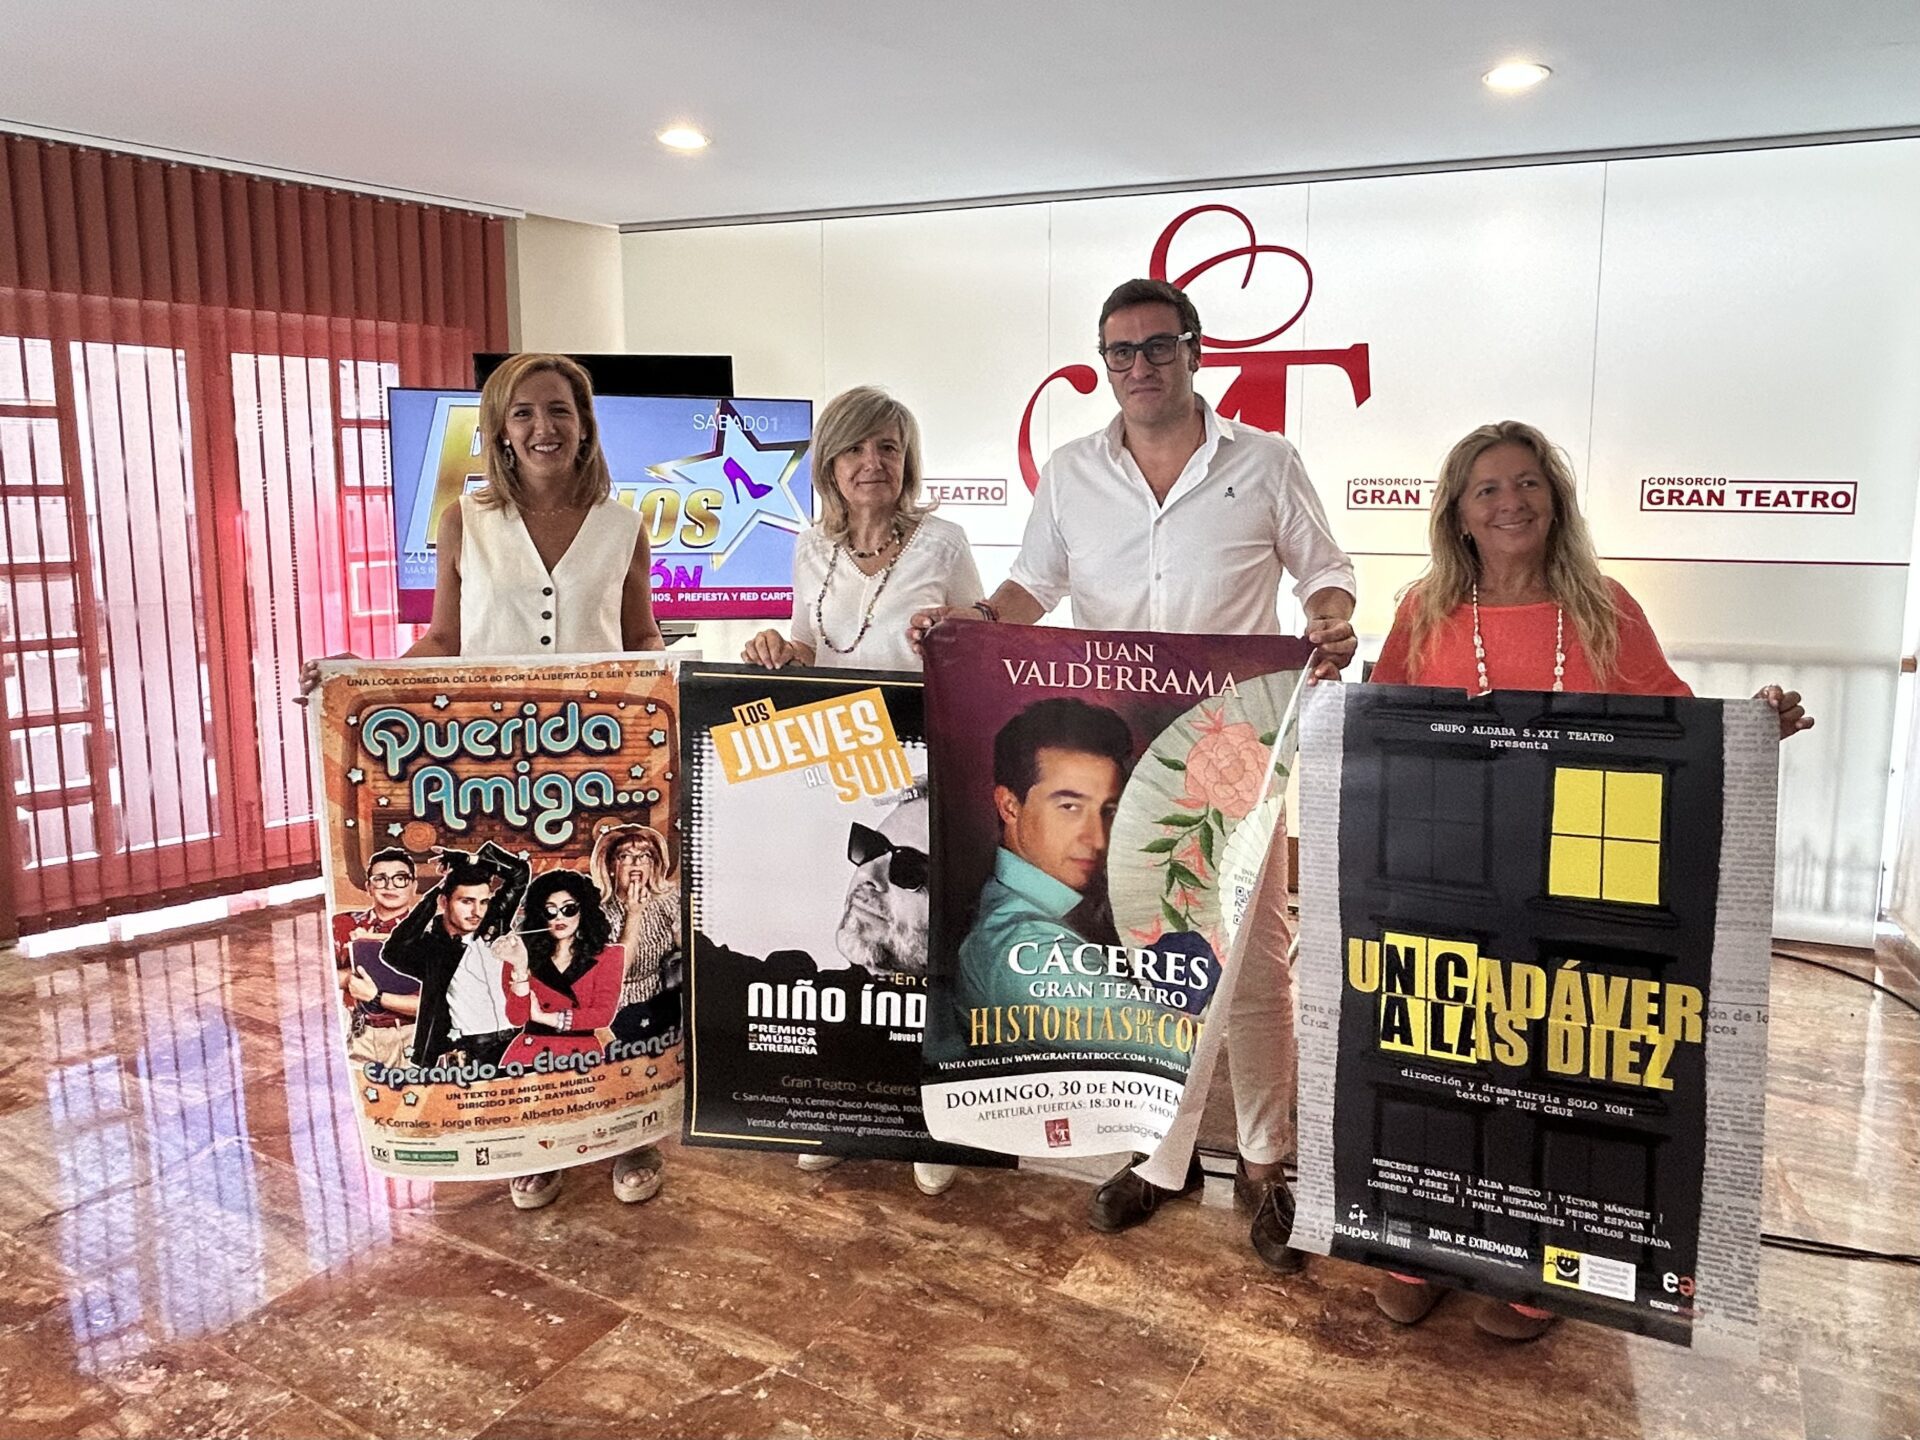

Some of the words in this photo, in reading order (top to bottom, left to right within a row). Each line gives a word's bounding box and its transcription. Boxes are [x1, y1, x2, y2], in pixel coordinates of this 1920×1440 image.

[926, 485, 1004, 500] TEATRO
[1353, 478, 1422, 486] CONSORCIO
[1648, 477, 1727, 486] CONSORCIO
[1352, 489, 1420, 505] GRAN
[1646, 489, 1725, 506] GRAN
[1736, 490, 1852, 508] TEATRO
[678, 592, 729, 601] PREFIESTA
[731, 592, 740, 601] Y
[740, 592, 758, 601] RED
[1084, 640, 1154, 665] JUAN
[347, 678, 370, 687] UNA
[372, 678, 399, 686] LOCA
[402, 677, 449, 685] COMEDIA
[452, 675, 465, 683] DE
[469, 675, 487, 683] LOS
[528, 673, 539, 681] LA
[542, 671, 588, 681] LIBERTAD
[591, 671, 603, 679] DE
[606, 670, 623, 678] SER
[627, 670, 632, 678] Y
[634, 669, 667, 678] SENTIR
[1002, 659, 1240, 698] VALDERRAMA
[738, 702, 770, 727] LOS
[362, 702, 622, 776] Querida
[730, 700, 883, 777] JUEVES
[1430, 723, 1466, 733] GRUPO
[1472, 726, 1516, 737] ALDABA
[1523, 729, 1560, 740] S.XXI
[1567, 731, 1615, 743] TEATRO
[1490, 738, 1549, 751] presenta
[804, 765, 826, 788] AL
[1008, 934, 1209, 990] CÁCERES
[1029, 981, 1094, 999] GRAN
[1100, 982, 1188, 1009] TEATRO
[1349, 937, 1416, 997] UN
[1435, 951, 1703, 1043] CADÁVER
[969, 1004, 1134, 1047] HISTORIAS
[1136, 1008, 1155, 1027] DE
[1733, 1009, 1751, 1022] de
[748, 1023, 817, 1036] PREMIOS
[759, 1033, 818, 1047] MÚSICA
[1136, 1025, 1154, 1045] LA
[748, 1042, 818, 1055] EXTREMEÑA
[1381, 993, 1414, 1047] A
[1430, 1001, 1528, 1067] LAS
[1547, 1021, 1674, 1091] DIEZ
[364, 1061, 496, 1088] Esperando
[507, 1061, 524, 1077] a
[533, 1050, 600, 1073] Elena
[1014, 1052, 1146, 1063] WWW.GRANTEATROCC.COM
[464, 1090, 497, 1100] TEXTO
[517, 1083, 557, 1094] MIGUEL
[560, 1074, 606, 1087] MURILLO
[743, 1092, 760, 1101] San
[781, 1075, 812, 1089] Gran
[815, 1078, 857, 1092] Teatro
[866, 1081, 917, 1097] Cáceres
[946, 1082, 1054, 1110] DOMINGO,
[1058, 1080, 1081, 1096] 30
[1086, 1083, 1107, 1095] DE
[1401, 1068, 1462, 1087] dirección
[1468, 1082, 1475, 1091] y
[1481, 1082, 1560, 1105] dramaturgia
[1567, 1098, 1598, 1111] SOLO
[1604, 1104, 1635, 1118] YONI
[457, 1100, 505, 1110] DIRIGIDO
[508, 1096, 530, 1105] POR
[544, 1086, 596, 1101] RAYNAUD
[977, 1107, 1034, 1121] APERTURA
[1089, 1098, 1121, 1110] 18:30
[1124, 1100, 1138, 1109] H.
[1456, 1089, 1491, 1103] texto
[1515, 1100, 1537, 1111] LUZ
[1543, 1105, 1574, 1118] CRUZ
[387, 1117, 431, 1129] Corrales
[440, 1117, 472, 1130] Jorge
[474, 1114, 511, 1126] Rivero
[521, 1108, 564, 1121] Alberto
[567, 1097, 617, 1116] Madruga
[747, 1118, 776, 1128] Ventas
[777, 1119, 789, 1129] de
[786, 1108, 825, 1120] Apertura
[826, 1110, 837, 1120] de
[838, 1112, 872, 1123] puertas
[1372, 1157, 1420, 1174] MERCEDES
[1424, 1168, 1461, 1182] GARCÍA
[1478, 1179, 1504, 1191] ALBA
[1559, 1194, 1599, 1210] VÍCTOR
[1604, 1203, 1651, 1220] MÁRQUEZ
[1367, 1179, 1408, 1194] LOURDES
[1412, 1189, 1455, 1204] GUILLÉN
[1472, 1201, 1504, 1215] PAULA
[1508, 1209, 1565, 1227] HERNÁNDEZ
[1583, 1224, 1624, 1239] CARLOS
[1629, 1233, 1672, 1250] ESPADA
[1419, 1178, 1448, 1191] PÉREZ
[1502, 1195, 1548, 1211] HURTADO
[1565, 1207, 1599, 1221] PEDRO
[1603, 1216, 1644, 1231] ESPADA
[1334, 1223, 1380, 1242] aupex
[1428, 1227, 1452, 1243] JUNTA
[1455, 1234, 1467, 1246] DE
[1468, 1237, 1529, 1260] EXTREMADURA
